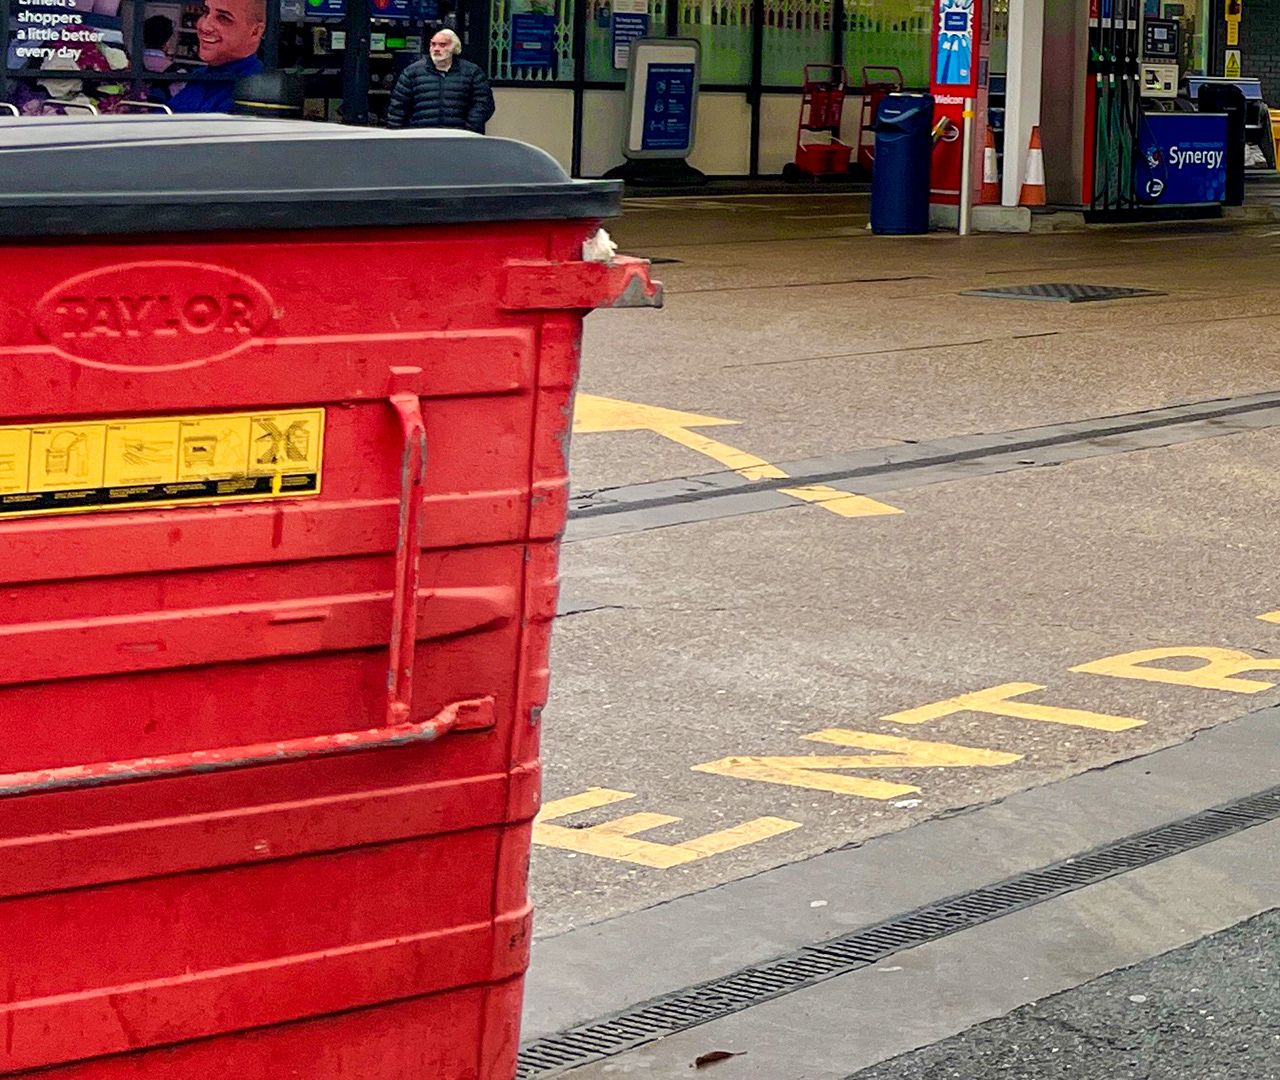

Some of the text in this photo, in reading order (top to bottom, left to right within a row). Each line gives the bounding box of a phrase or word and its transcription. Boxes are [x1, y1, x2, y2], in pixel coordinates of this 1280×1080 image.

[17, 10, 83, 26] shoppers
[17, 27, 105, 42] a little better
[16, 46, 82, 61] every day
[934, 95, 964, 105] Welcom
[1168, 146, 1224, 169] Synergy
[56, 293, 254, 338] TAYLOR
